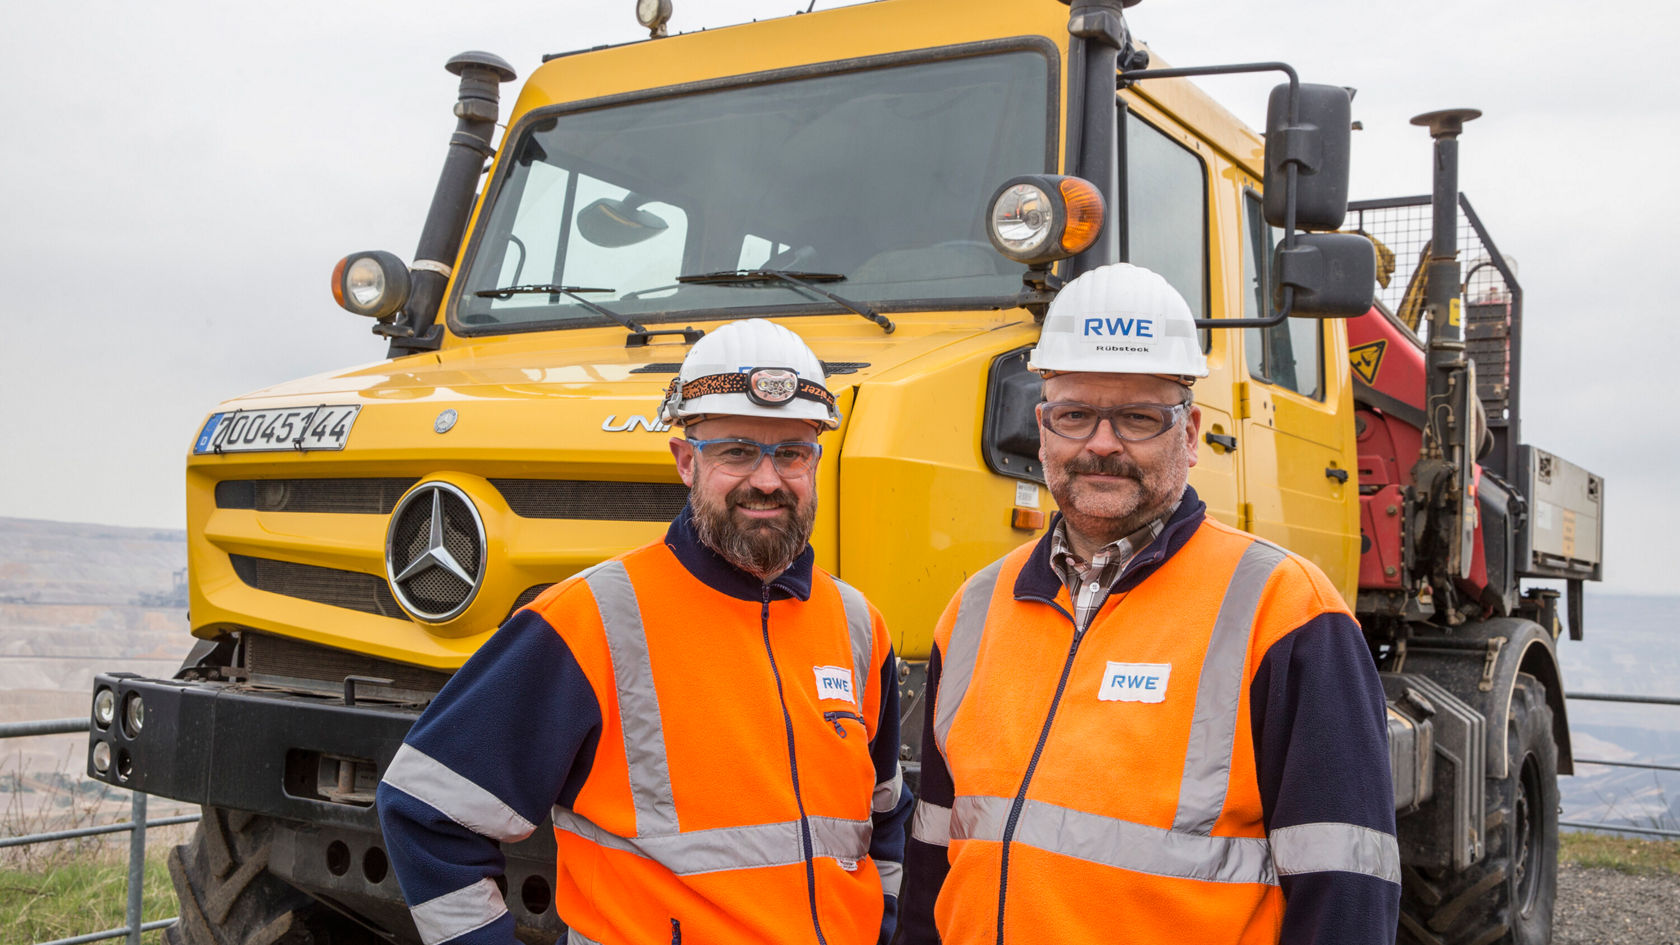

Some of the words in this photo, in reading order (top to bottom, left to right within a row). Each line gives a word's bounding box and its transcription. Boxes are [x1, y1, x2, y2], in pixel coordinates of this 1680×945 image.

[1084, 318, 1153, 338] RWE
[822, 677, 849, 692] RWE
[1111, 674, 1160, 690] RWE
